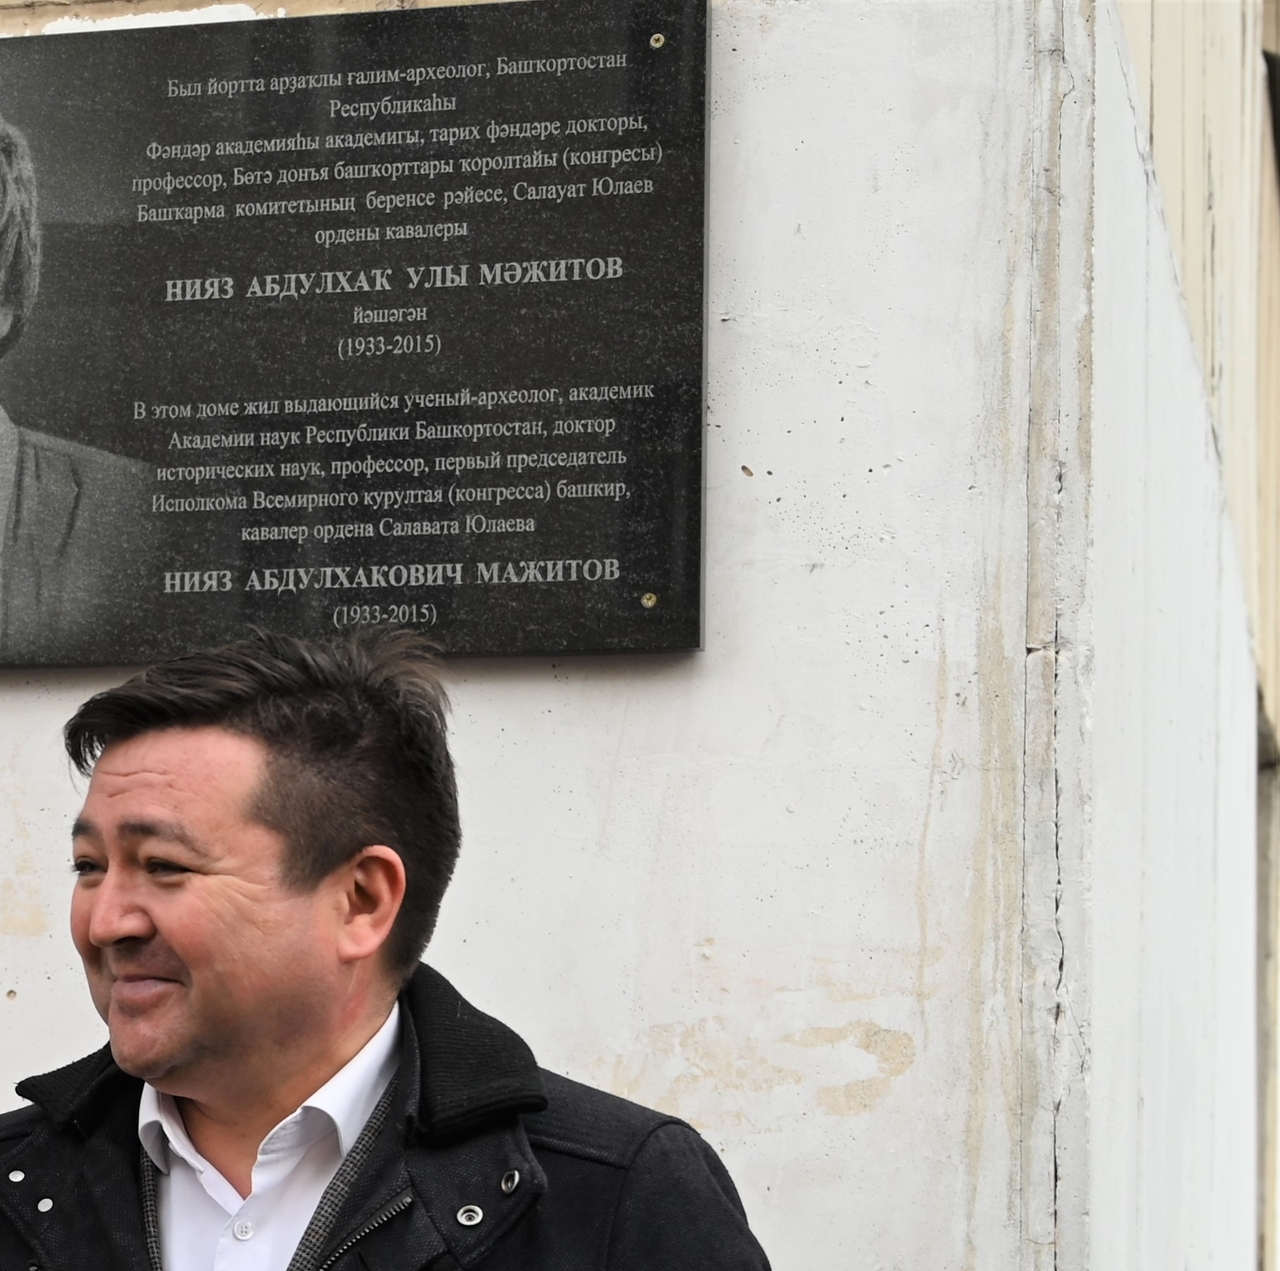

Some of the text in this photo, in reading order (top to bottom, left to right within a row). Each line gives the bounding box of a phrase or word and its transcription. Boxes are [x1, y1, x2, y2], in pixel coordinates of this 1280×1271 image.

[167, 79, 202, 97] Был
[207, 76, 265, 98] йортта
[347, 63, 490, 89] ғалим-археолог,
[496, 53, 627, 78] Башҡортостан
[329, 92, 456, 120] Республикаһы
[146, 114, 647, 164] Фәндәр академияһы академигы, тарих фәндәре докторы,
[132, 172, 228, 195] профессор,
[233, 167, 273, 186] Бөтә
[276, 163, 329, 185] донъя
[563, 142, 663, 171] (конгресы)
[235, 196, 356, 218] комитетының
[366, 189, 435, 213] беренсе
[443, 186, 508, 208] рәйесе,
[513, 181, 586, 205] Салауат
[592, 177, 653, 195] Юлаев
[315, 221, 468, 247] ордены кавалеры
[165, 257, 623, 302] НИЯЗ АБДУЛХАҠ УЛЫ МӘЖИТОВ
[353, 306, 427, 324] йәшәгән
[338, 334, 441, 360] (1933-2015)
[133, 383, 654, 420] В этом доме жил выдающийся ученый-археолог, академик
[168, 418, 615, 450] Академии наук Республики Башкортостан, доктор
[157, 450, 626, 484] исторических наук, профессор, первый председатель
[151, 479, 631, 512] Исполкома Всемирного курултая (конгресса) башкир,
[241, 515, 535, 544] кавалер ордена Салавата Юлаева
[163, 558, 620, 596] НИЯЗ АБДУЛХАКОВИЧ МАЖИТОВ
[333, 604, 437, 629] (1933-2015)
